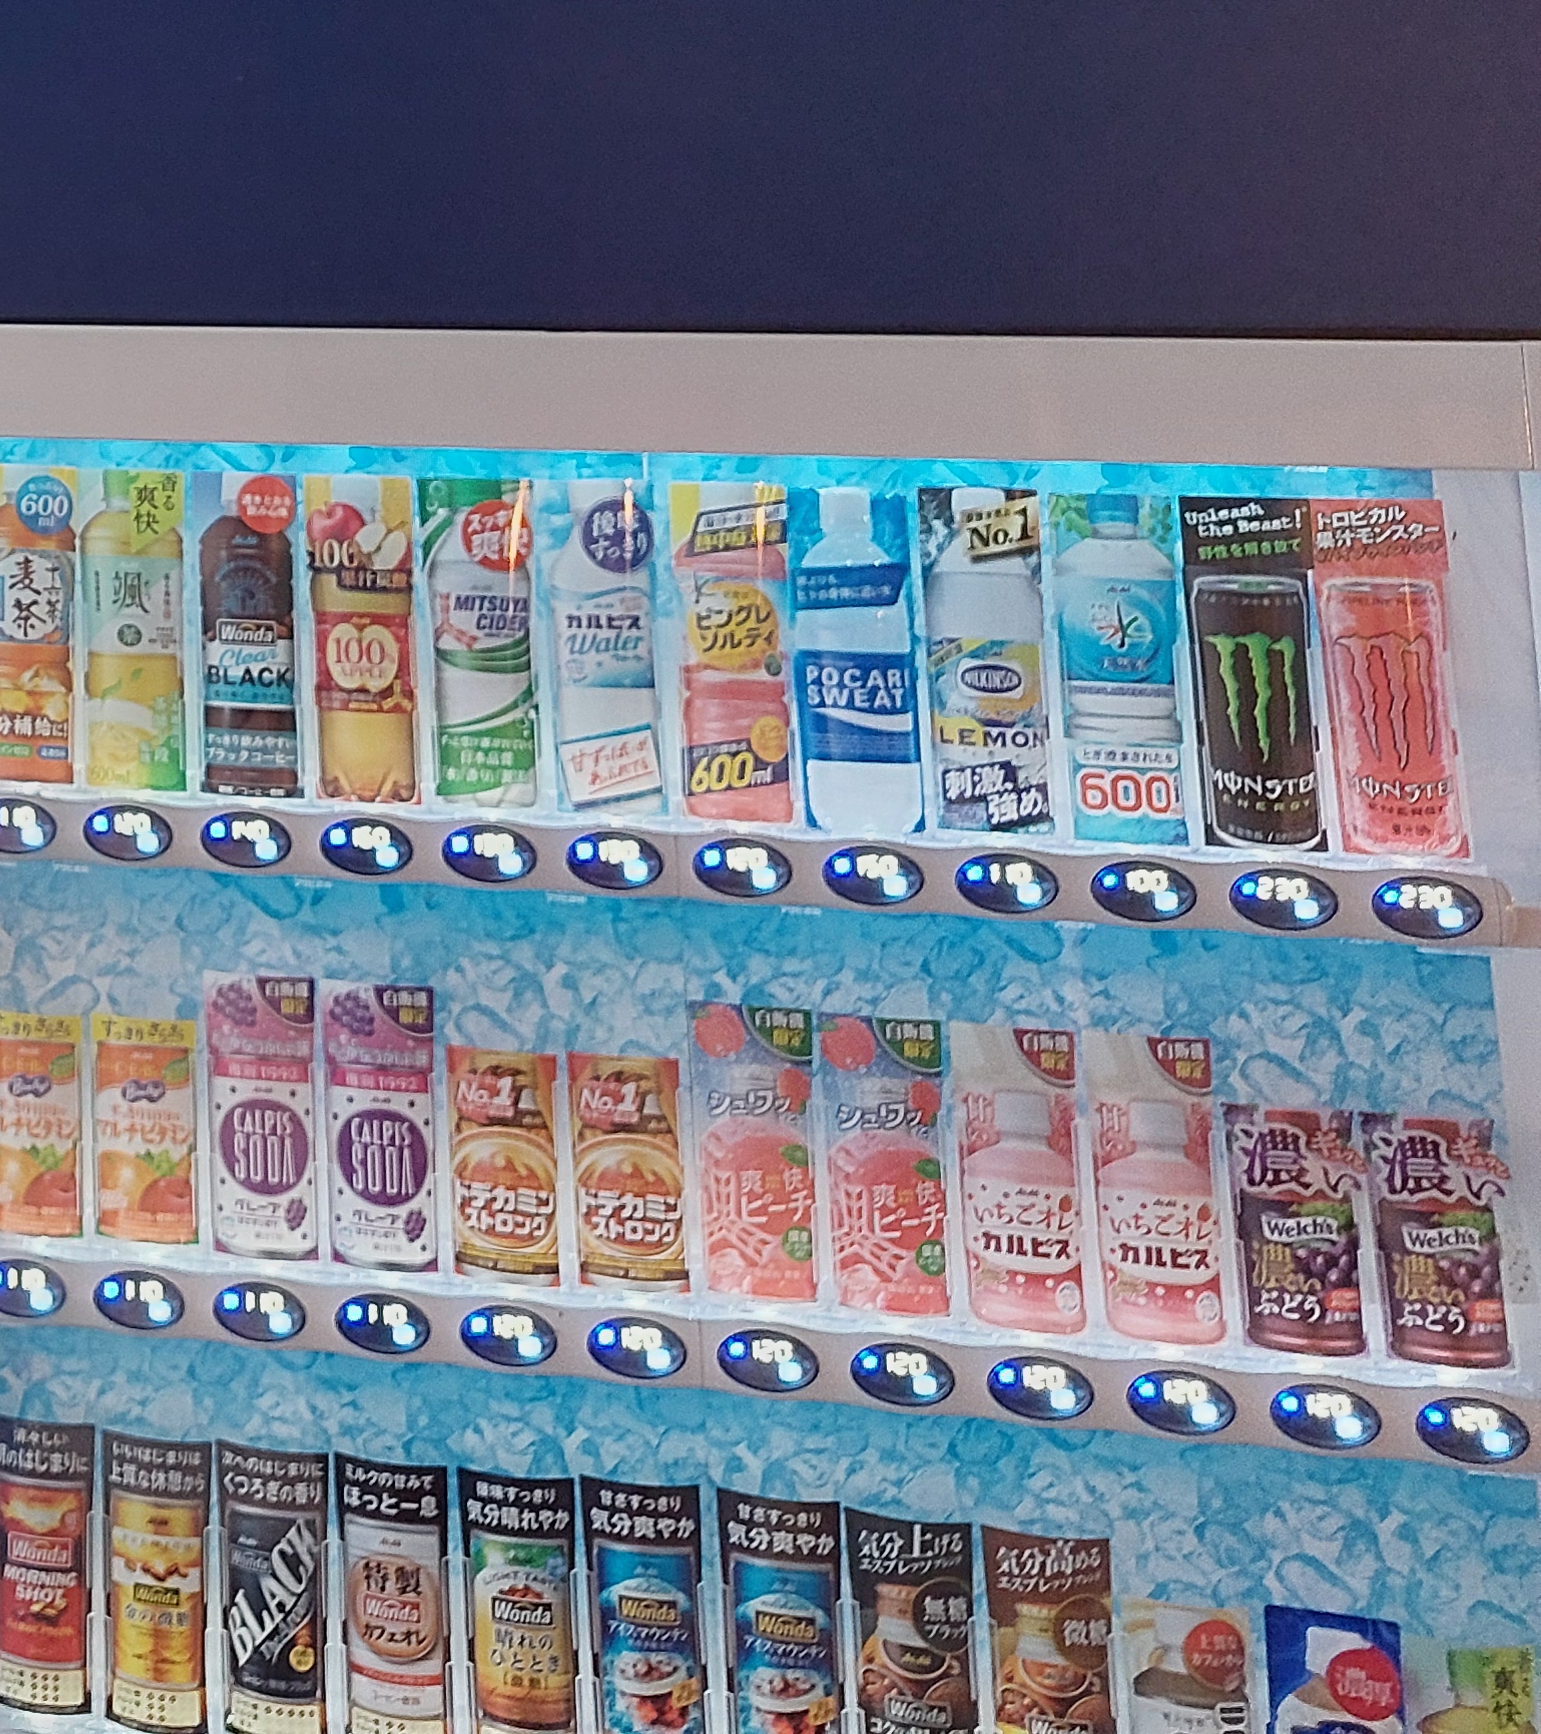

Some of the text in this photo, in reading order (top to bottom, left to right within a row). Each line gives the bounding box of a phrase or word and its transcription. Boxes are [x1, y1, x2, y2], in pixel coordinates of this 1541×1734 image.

[161, 472, 178, 511] 香る
[19, 494, 68, 517] 600
[134, 483, 161, 535] 爽快
[1184, 502, 1266, 526] Unleash
[1316, 504, 1407, 531] トロピカル
[967, 505, 1035, 551] No.1
[1197, 508, 1304, 539] the Beast!
[1315, 523, 1442, 550] 果汁モンスター
[8, 555, 47, 638] 麦茶
[113, 571, 150, 614] 颯
[453, 594, 529, 614] MITSUYA
[220, 624, 275, 644] Wonda
[475, 613, 529, 633] CIDER
[565, 614, 643, 630] カルピス
[332, 637, 386, 667] 100
[566, 632, 644, 656] Water
[700, 627, 776, 654] ソルティ
[218, 646, 281, 667] Clear
[206, 665, 292, 689] BLACK
[806, 666, 909, 688] POCARI
[963, 668, 1020, 690] WILKINSON
[806, 685, 905, 709] SWEAT
[939, 725, 1046, 749] LEMON
[206, 746, 297, 765] ブラックコーヒー
[944, 763, 1014, 800] 刺激、
[1079, 770, 1173, 814] 600
[986, 788, 1049, 825] 強め。
[1398, 885, 1452, 910] 230
[457, 1076, 515, 1109] No.1
[578, 1077, 640, 1112] No.1
[233, 1107, 294, 1136] CALPIS
[350, 1116, 412, 1146] CALPIS
[233, 1132, 297, 1186] SODA
[350, 1141, 417, 1198] SODA
[1240, 1126, 1362, 1193] 濃い
[1379, 1134, 1506, 1198] 濃い
[234, 1197, 285, 1215] グレープ
[352, 1208, 403, 1226] グレープ
[740, 1189, 814, 1225] ピーチ
[972, 1200, 1074, 1233] いちごオレ
[465, 1207, 548, 1237] ストロング
[590, 1214, 678, 1244] ストロング
[873, 1203, 946, 1239] ピーチ
[1109, 1212, 1213, 1242] いちごオレ
[1266, 1218, 1334, 1240] Welch's
[982, 1230, 1072, 1261] カルピス
[1407, 1229, 1477, 1250] Welch's
[1119, 1242, 1212, 1271] カルピス
[1253, 1290, 1321, 1323] ぶどう
[1396, 1302, 1466, 1335] ぶどう
[221, 1450, 326, 1477] 次へのはじまりに
[344, 1464, 435, 1489] ミルクの甘みで
[109, 1463, 205, 1493] 上質な休憩から
[223, 1472, 321, 1504] くつろぎの香り
[343, 1485, 439, 1517] ほっと一息
[599, 1489, 682, 1513] 甘さすっきり
[467, 1499, 570, 1531] 気分晴れやか
[590, 1507, 696, 1539] 気分爽やか
[736, 1502, 822, 1528] 甘さすっきり
[11, 1539, 70, 1563] Wonda
[728, 1520, 835, 1556] 気分爽やか
[857, 1523, 964, 1560] 気分上げる
[994, 1540, 1102, 1577] 気分高める
[3, 1563, 79, 1588] MORNING
[362, 1561, 422, 1596] 特製
[15, 1583, 68, 1603] SHOT
[134, 1586, 180, 1606] Wonda
[228, 1519, 319, 1668] BLACK
[365, 1597, 421, 1623] Wonda
[493, 1600, 553, 1625] Wonda
[620, 1599, 679, 1624] Wonda
[923, 1596, 968, 1621] 無糖
[362, 1623, 428, 1648] カフェオレ
[493, 1627, 554, 1651] 晴れの
[607, 1621, 689, 1643] アイスマウンテン
[756, 1613, 817, 1640] Wonda
[1062, 1618, 1108, 1646] 微糖
[489, 1647, 560, 1673] ひととき
[743, 1634, 828, 1660] アイスマウンテン
[1336, 1665, 1393, 1706] 濃厚
[890, 1699, 948, 1725] Wonda
